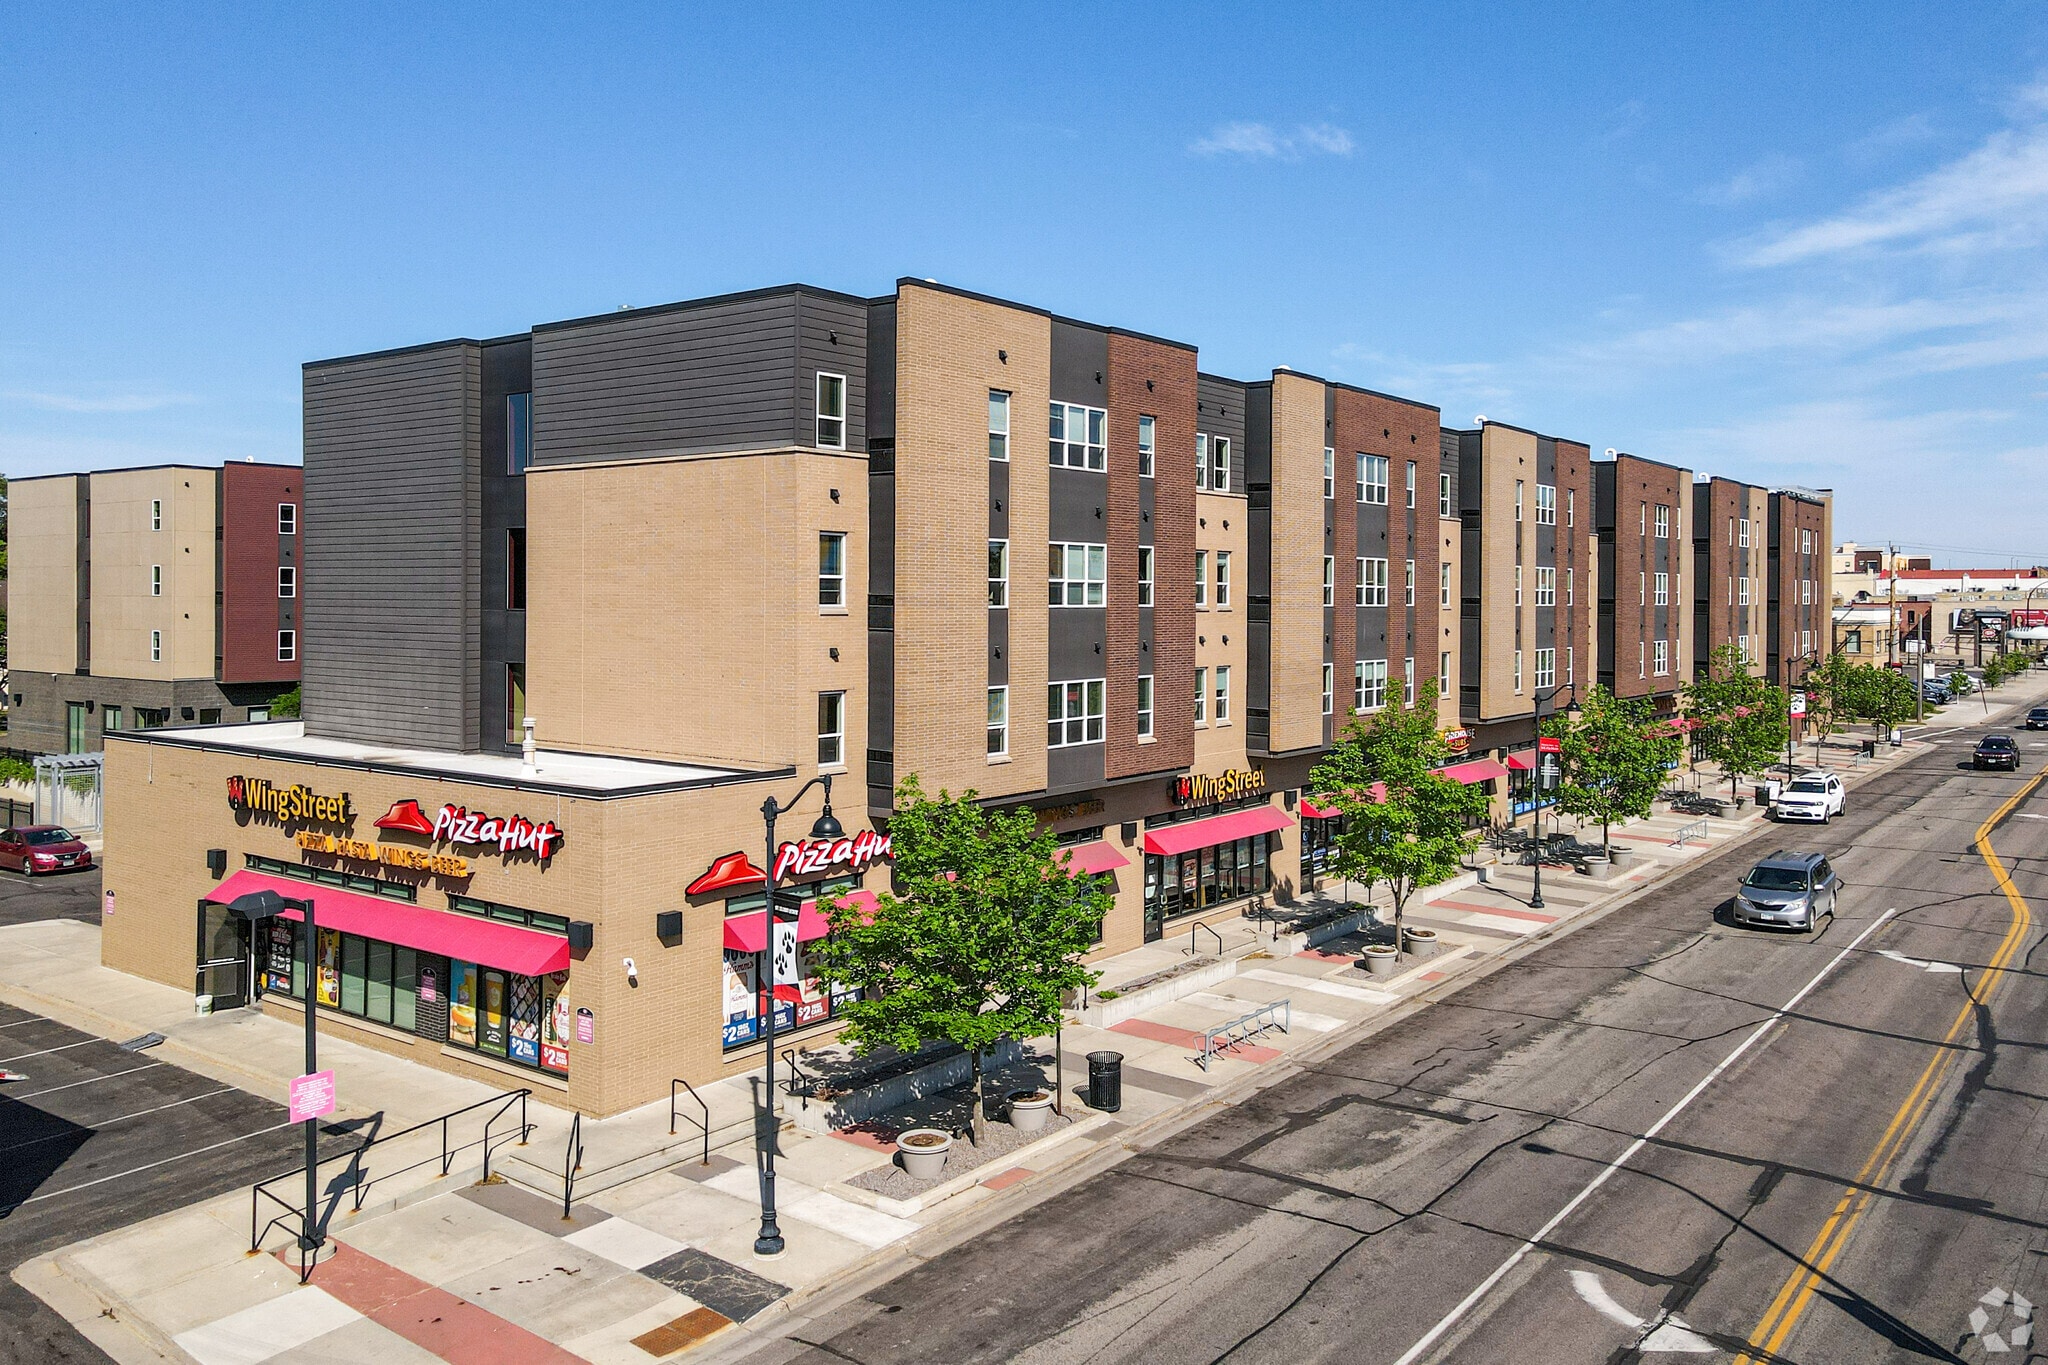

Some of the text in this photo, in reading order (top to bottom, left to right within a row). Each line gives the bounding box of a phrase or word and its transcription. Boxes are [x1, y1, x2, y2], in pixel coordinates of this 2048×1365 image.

[245, 777, 346, 824] WingStreet
[1191, 765, 1265, 803] WingStreet
[432, 805, 560, 859] Pizza Hut
[294, 830, 469, 878] PIZZA PASTA WINGS BEER
[774, 832, 892, 882] Pizza Hu
[798, 1005, 811, 1021] $2
[511, 1037, 524, 1056] $2
[723, 1025, 737, 1042] $2
[544, 1046, 556, 1066] $2
